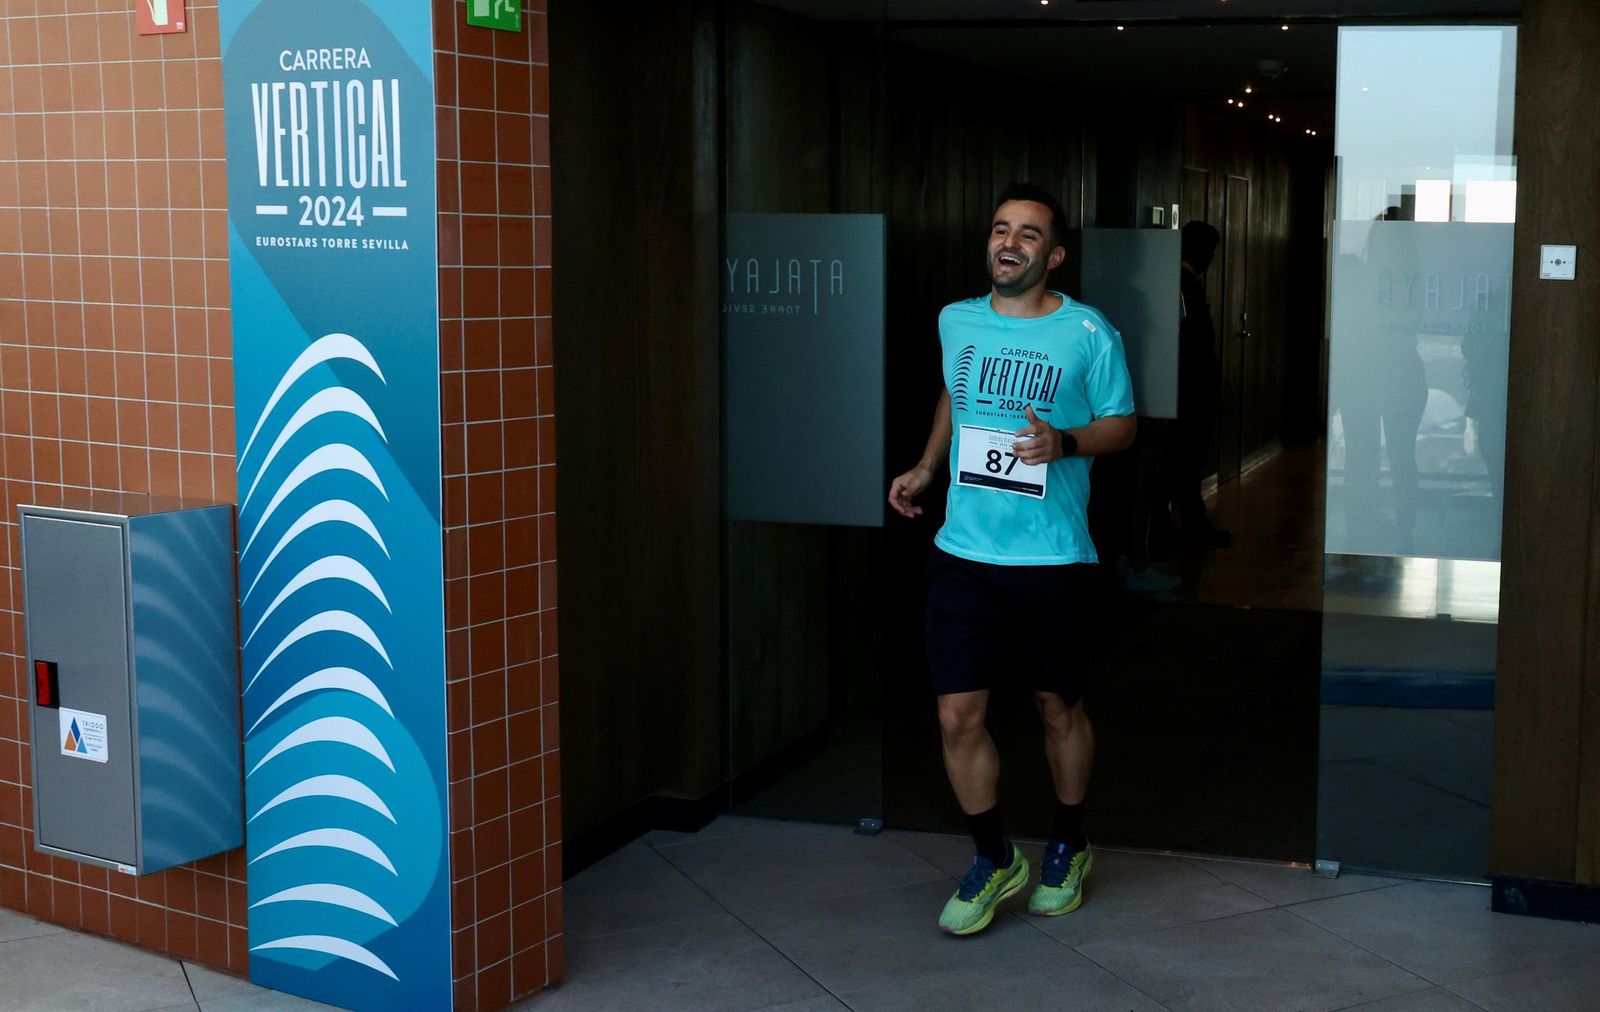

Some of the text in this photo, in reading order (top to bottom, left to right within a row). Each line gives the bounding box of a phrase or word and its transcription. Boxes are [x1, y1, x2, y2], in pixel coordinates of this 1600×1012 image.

[279, 47, 371, 71] CARRERA
[251, 79, 407, 189] VERTICAL
[299, 195, 364, 227] 2024
[256, 236, 409, 250] EUROSTARS TORRE SEVILLA
[1000, 347, 1050, 362] CARRERA
[979, 356, 1063, 404] VERTICAL
[985, 449, 1020, 476] 87
